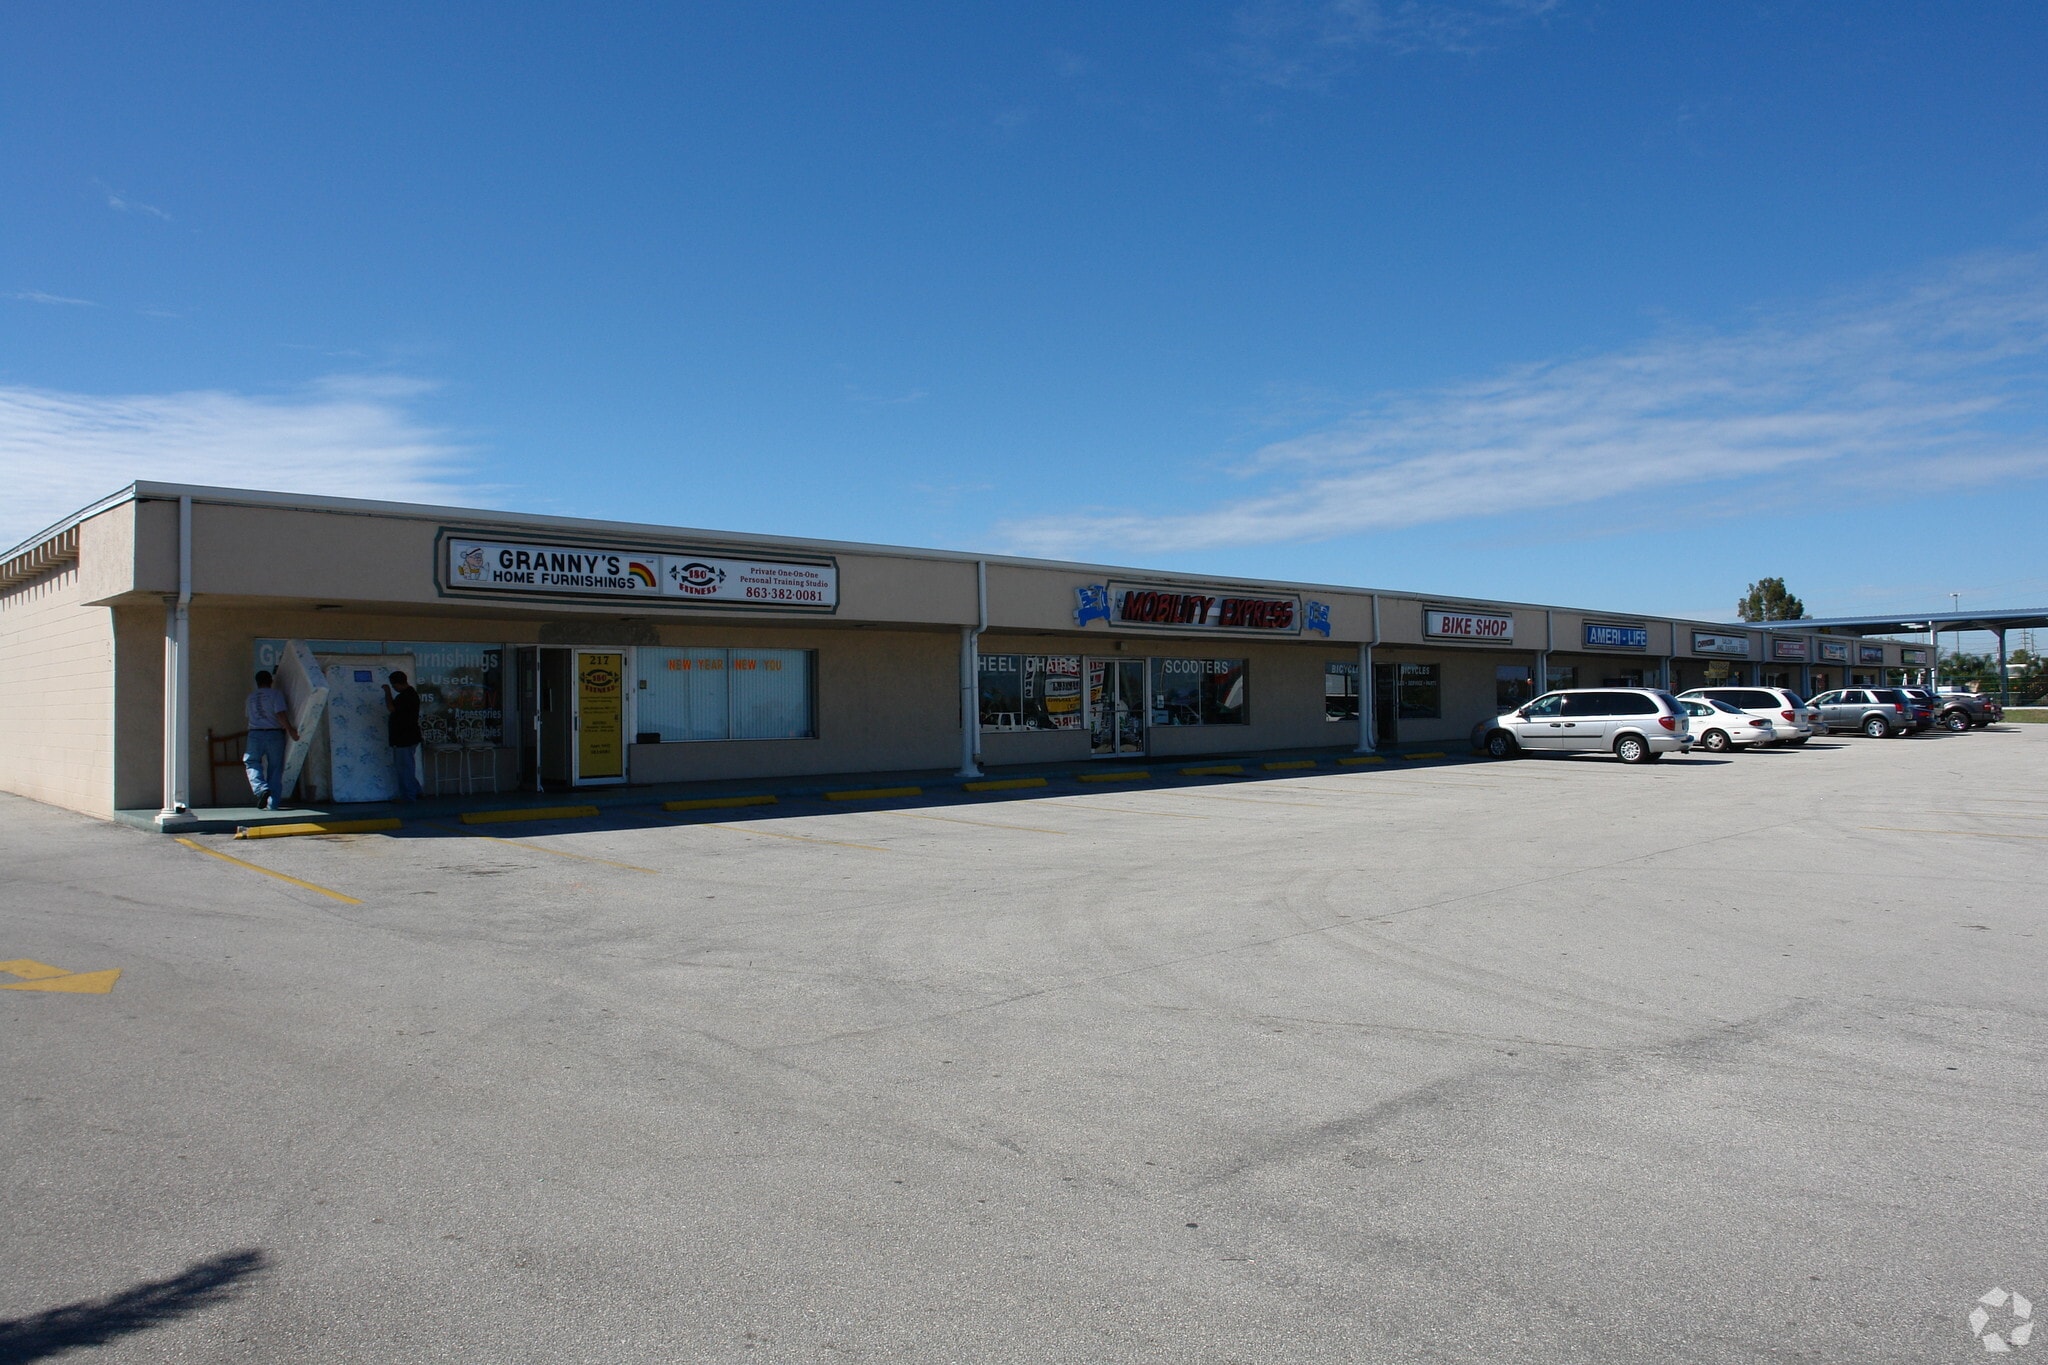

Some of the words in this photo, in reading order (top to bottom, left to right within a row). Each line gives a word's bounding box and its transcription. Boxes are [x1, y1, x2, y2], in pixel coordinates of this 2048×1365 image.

[499, 549, 620, 575] GRANNY'S
[750, 567, 776, 576] Private
[777, 568, 818, 578] One-On-One
[493, 570, 535, 583] HOME
[542, 573, 635, 589] FURNISHINGS
[740, 575, 772, 584] Personal
[773, 577, 805, 588] Training
[807, 579, 828, 588] Studio
[679, 582, 717, 595] FITNESS
[1121, 590, 1215, 624] MOBILITY
[1219, 598, 1293, 628] EXPRESS
[1441, 616, 1472, 635] BIKE
[1475, 618, 1507, 636] SHOP
[1589, 627, 1621, 645] AMERI
[1628, 630, 1646, 645] LIFE
[404, 647, 499, 673] urnishings
[589, 656, 609, 665] 217
[669, 659, 691, 670] NEW
[698, 659, 723, 670] YEAR
[734, 659, 757, 670] NEW
[764, 660, 782, 670] YOU
[978, 657, 1016, 672] HEEL
[1165, 660, 1229, 674] SCOOTERS
[1331, 664, 1360, 674] BICYCL
[1400, 666, 1430, 675] BICYCLES
[431, 674, 474, 685] Used:
